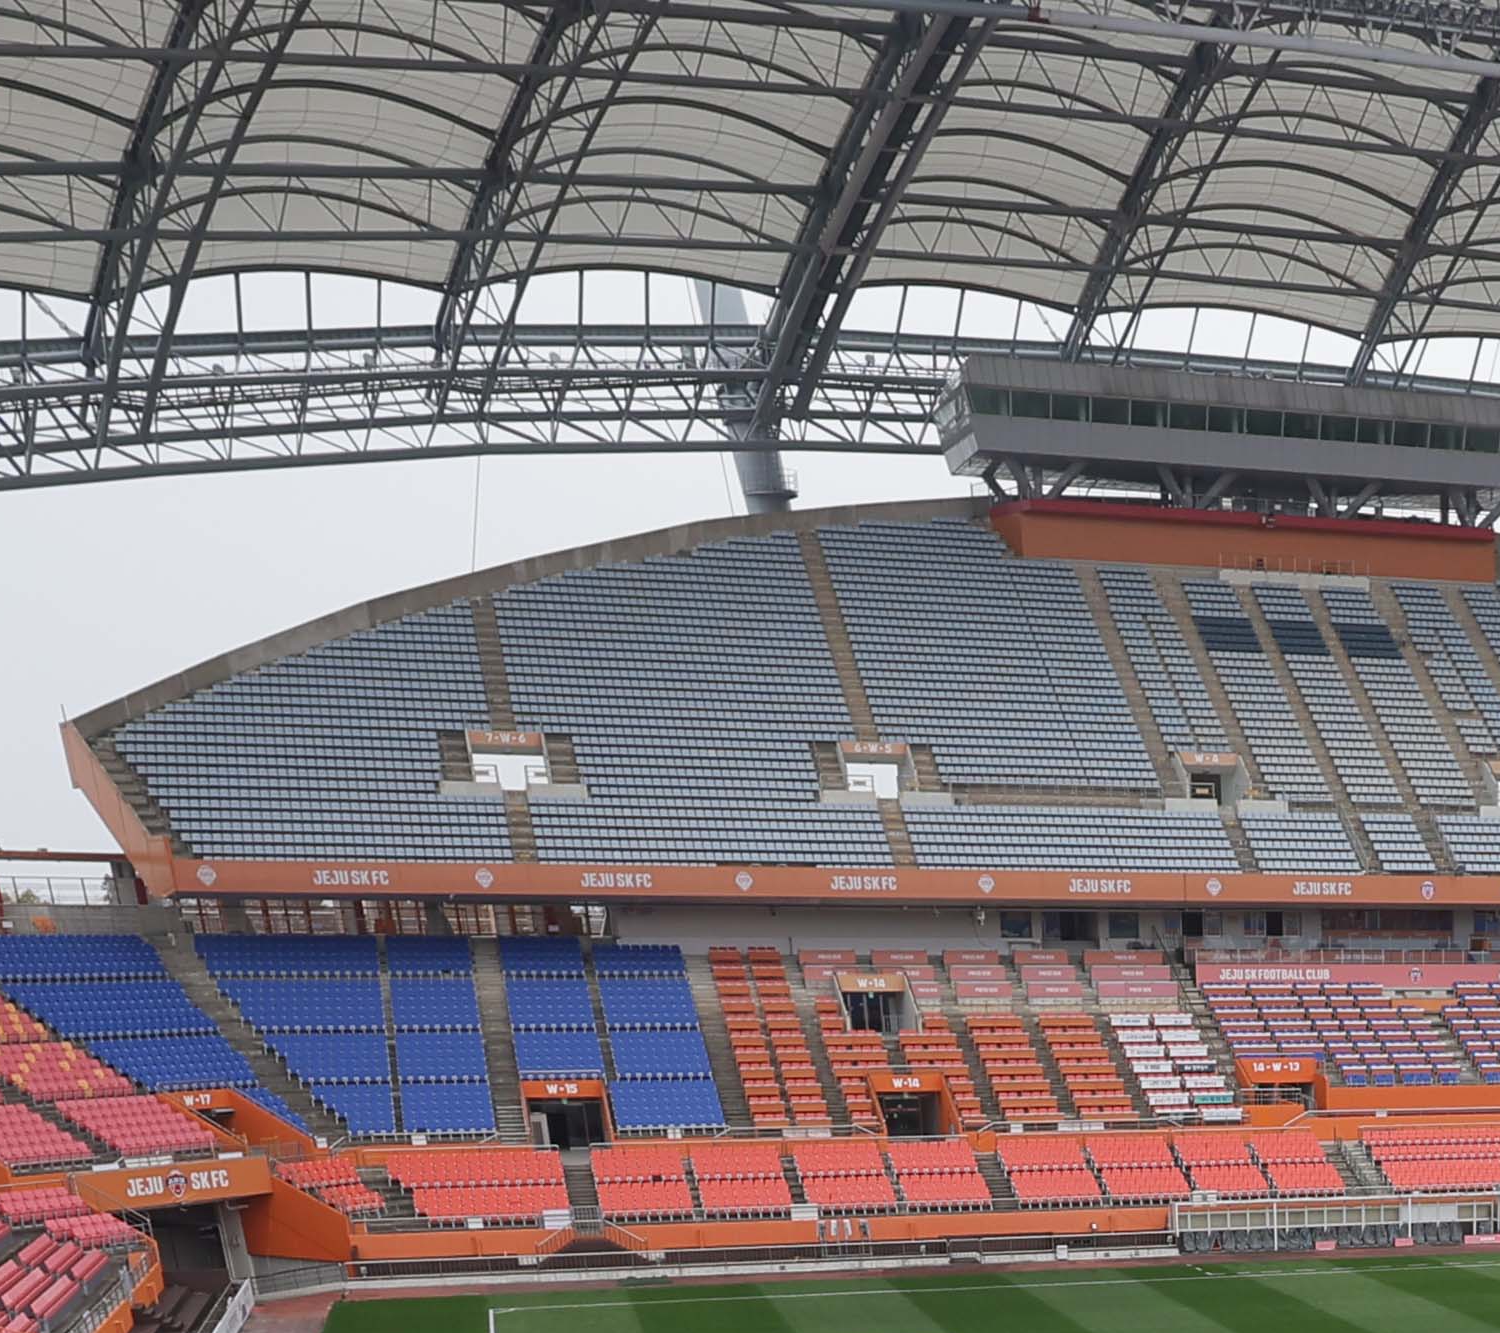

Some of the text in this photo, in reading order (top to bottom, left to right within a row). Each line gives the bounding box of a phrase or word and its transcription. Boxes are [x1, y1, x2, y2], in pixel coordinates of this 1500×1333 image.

[313, 869, 389, 886] JEJU SK FC
[581, 871, 652, 888] JEJU SK FC
[1220, 968, 1330, 981] JEJU SK FOOTBALL CLUB
[127, 1169, 229, 1198] JEJU SK FC
